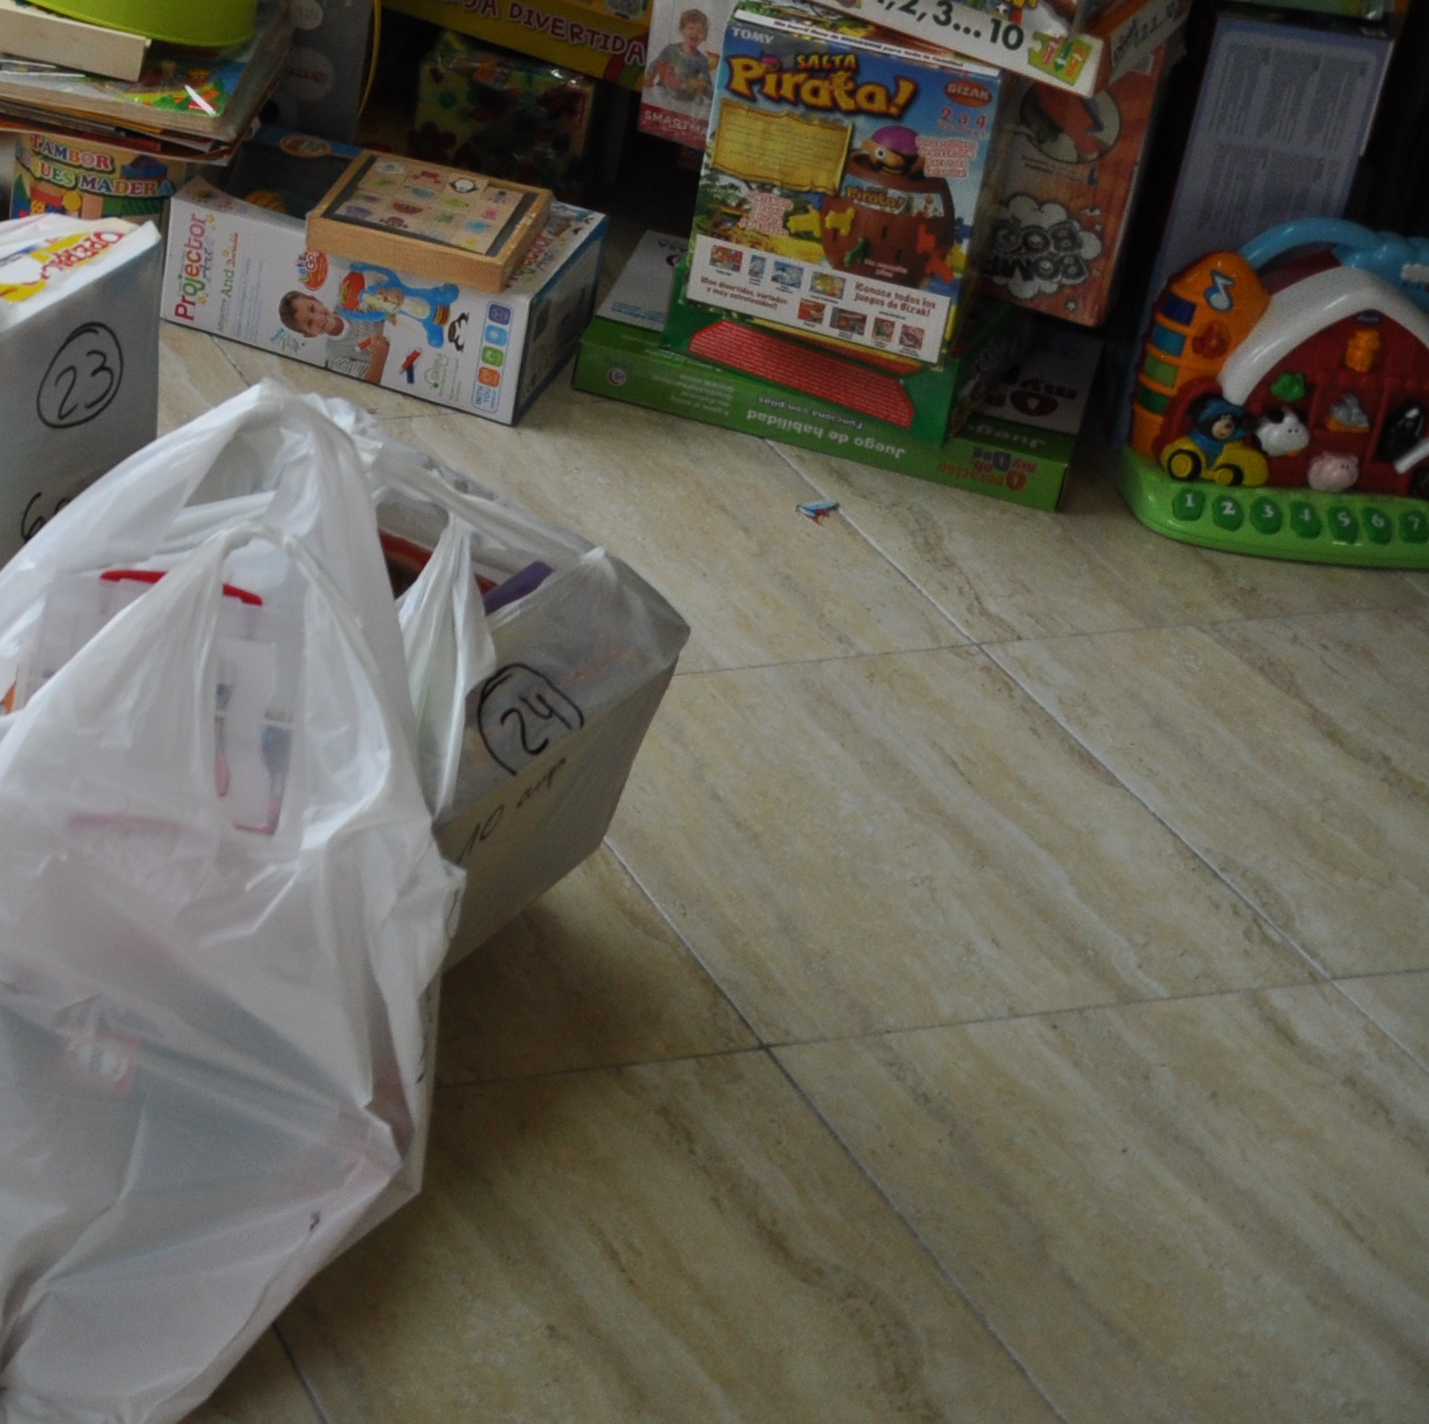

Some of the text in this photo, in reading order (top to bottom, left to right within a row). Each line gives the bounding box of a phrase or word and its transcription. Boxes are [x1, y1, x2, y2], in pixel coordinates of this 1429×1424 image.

[508, 1, 647, 65] DIVERTIDA
[731, 27, 775, 45] TOMY
[795, 53, 858, 72] SALTA
[725, 53, 917, 117] Pirata!
[947, 83, 991, 103] BIZAK
[30, 133, 112, 170] TAMBOR
[79, 168, 175, 199] MADERA
[174, 212, 207, 322] Projector
[221, 268, 235, 298] And
[854, 292, 931, 318] juegos de Bizak!
[895, 289, 919, 304] todos
[922, 297, 936, 310] los
[56, 348, 118, 422] 23
[757, 395, 785, 415] pilas
[791, 406, 812, 420] con
[817, 412, 864, 431] Funciona
[746, 408, 907, 462] Juego de habilidad
[1184, 493, 1195, 508] 1
[1220, 501, 1237, 517] 2
[1261, 503, 1275, 519] 3
[1299, 508, 1312, 523] 4
[1337, 511, 1351, 527] 5
[1370, 514, 1385, 528] 6
[1408, 516, 1421, 531] 7
[499, 694, 571, 760] 24
